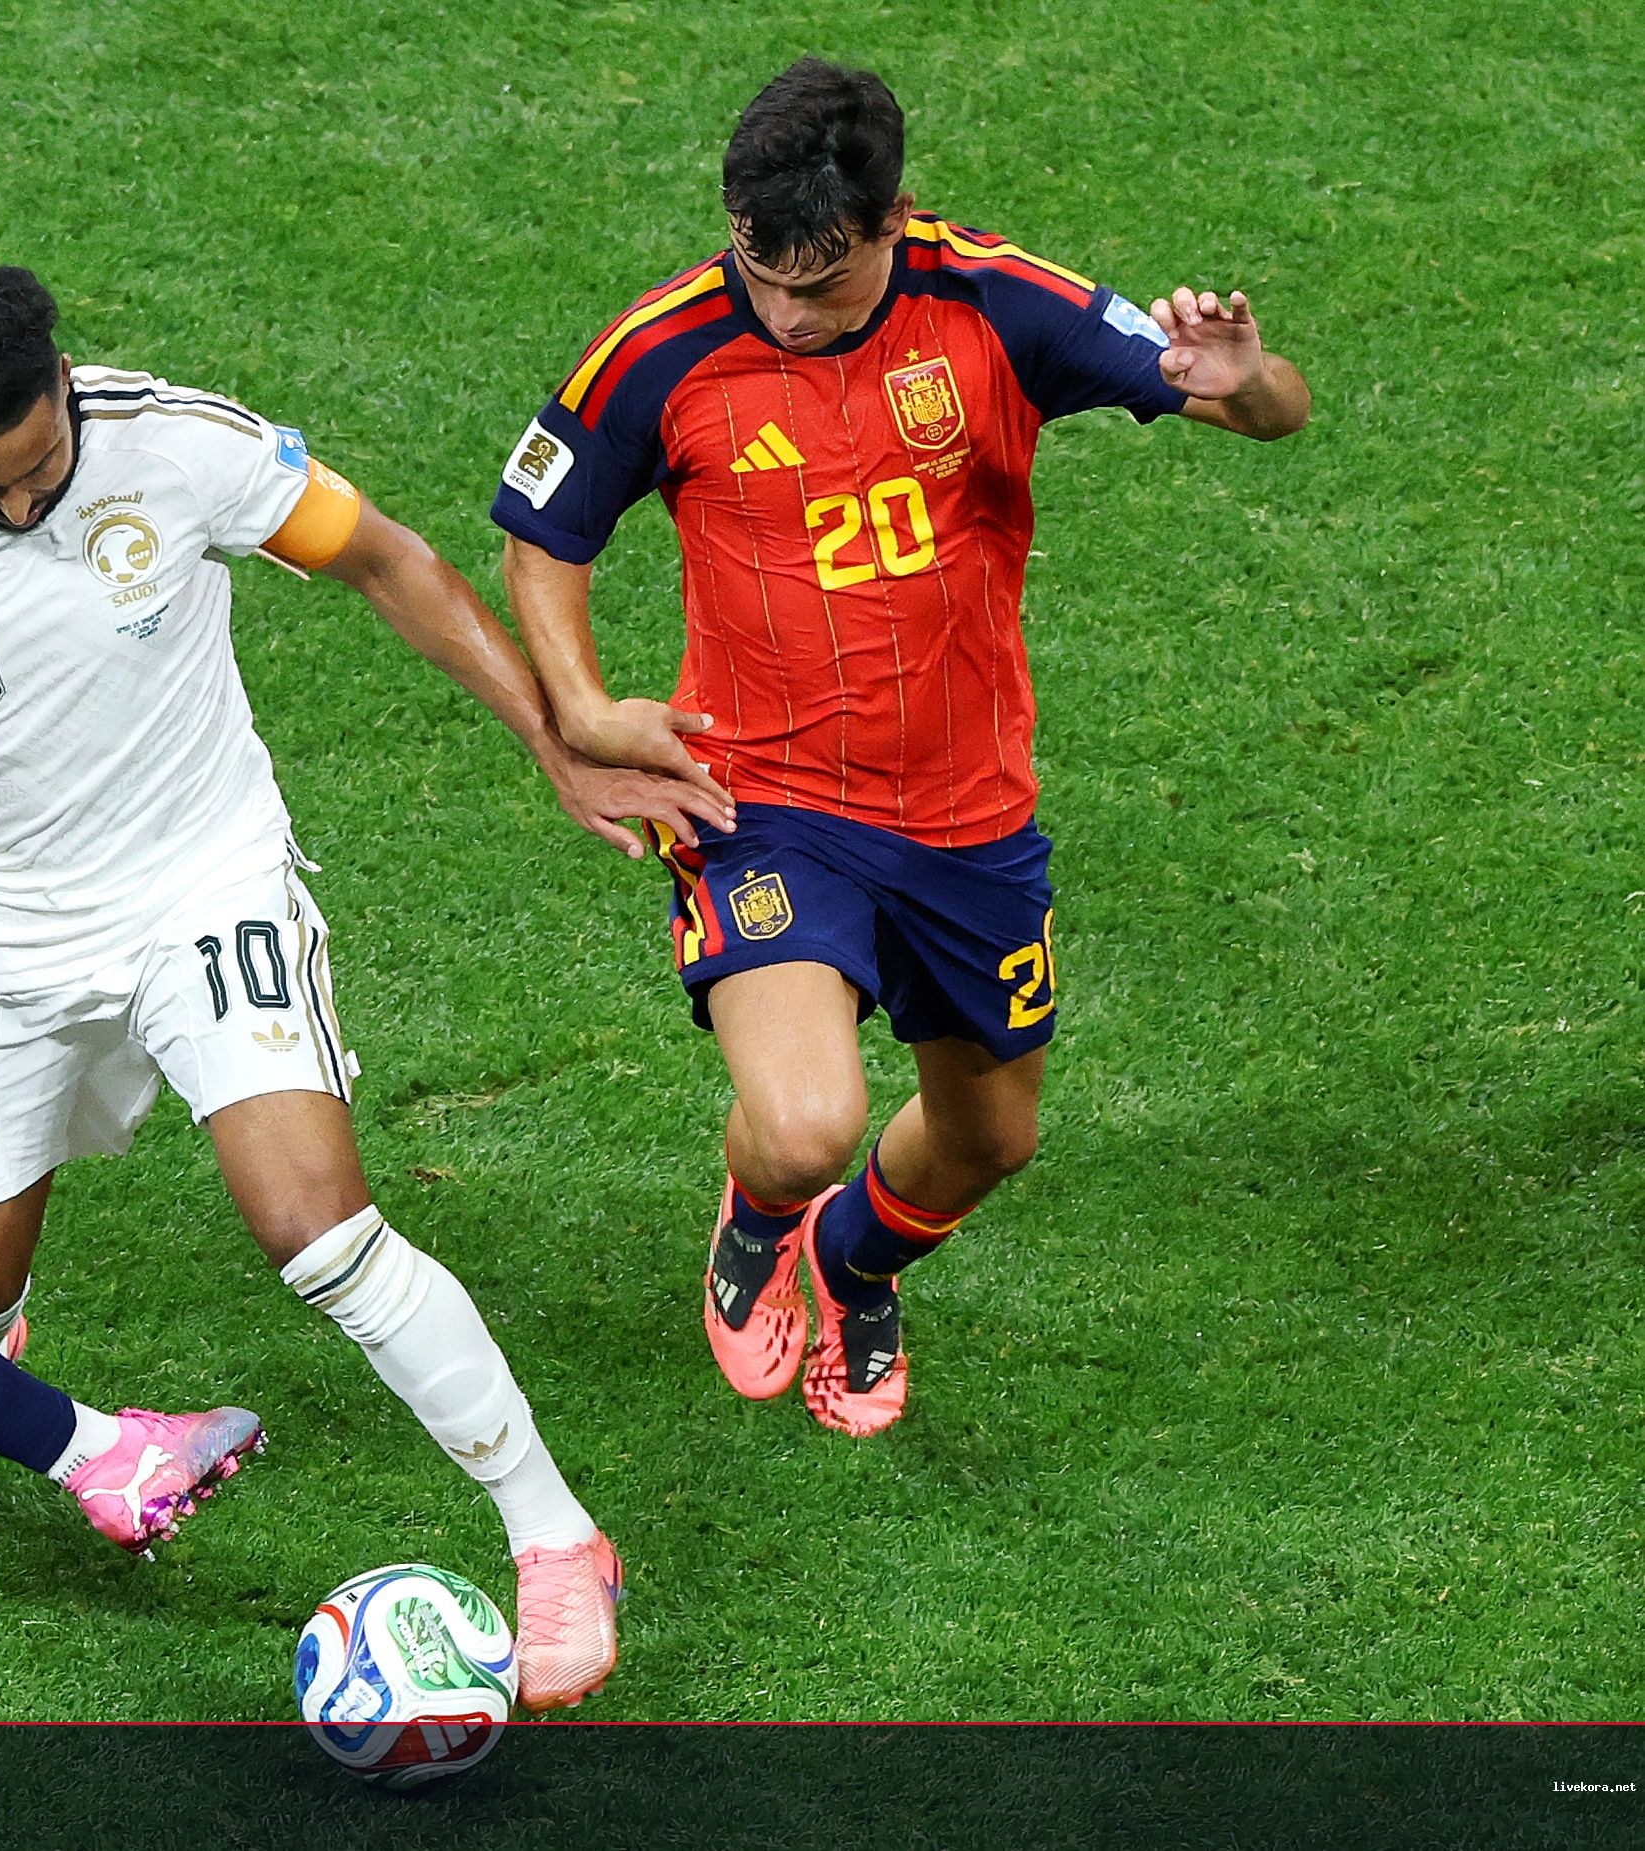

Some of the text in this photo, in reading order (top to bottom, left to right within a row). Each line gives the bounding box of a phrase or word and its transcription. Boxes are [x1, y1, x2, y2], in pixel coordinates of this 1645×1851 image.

[75, 489, 144, 520] السعودية
[805, 476, 935, 591] 20
[128, 549, 152, 563] SAFF
[111, 583, 159, 609] SAUDI
[194, 920, 294, 1023] 10
[998, 907, 1056, 1030] 2
